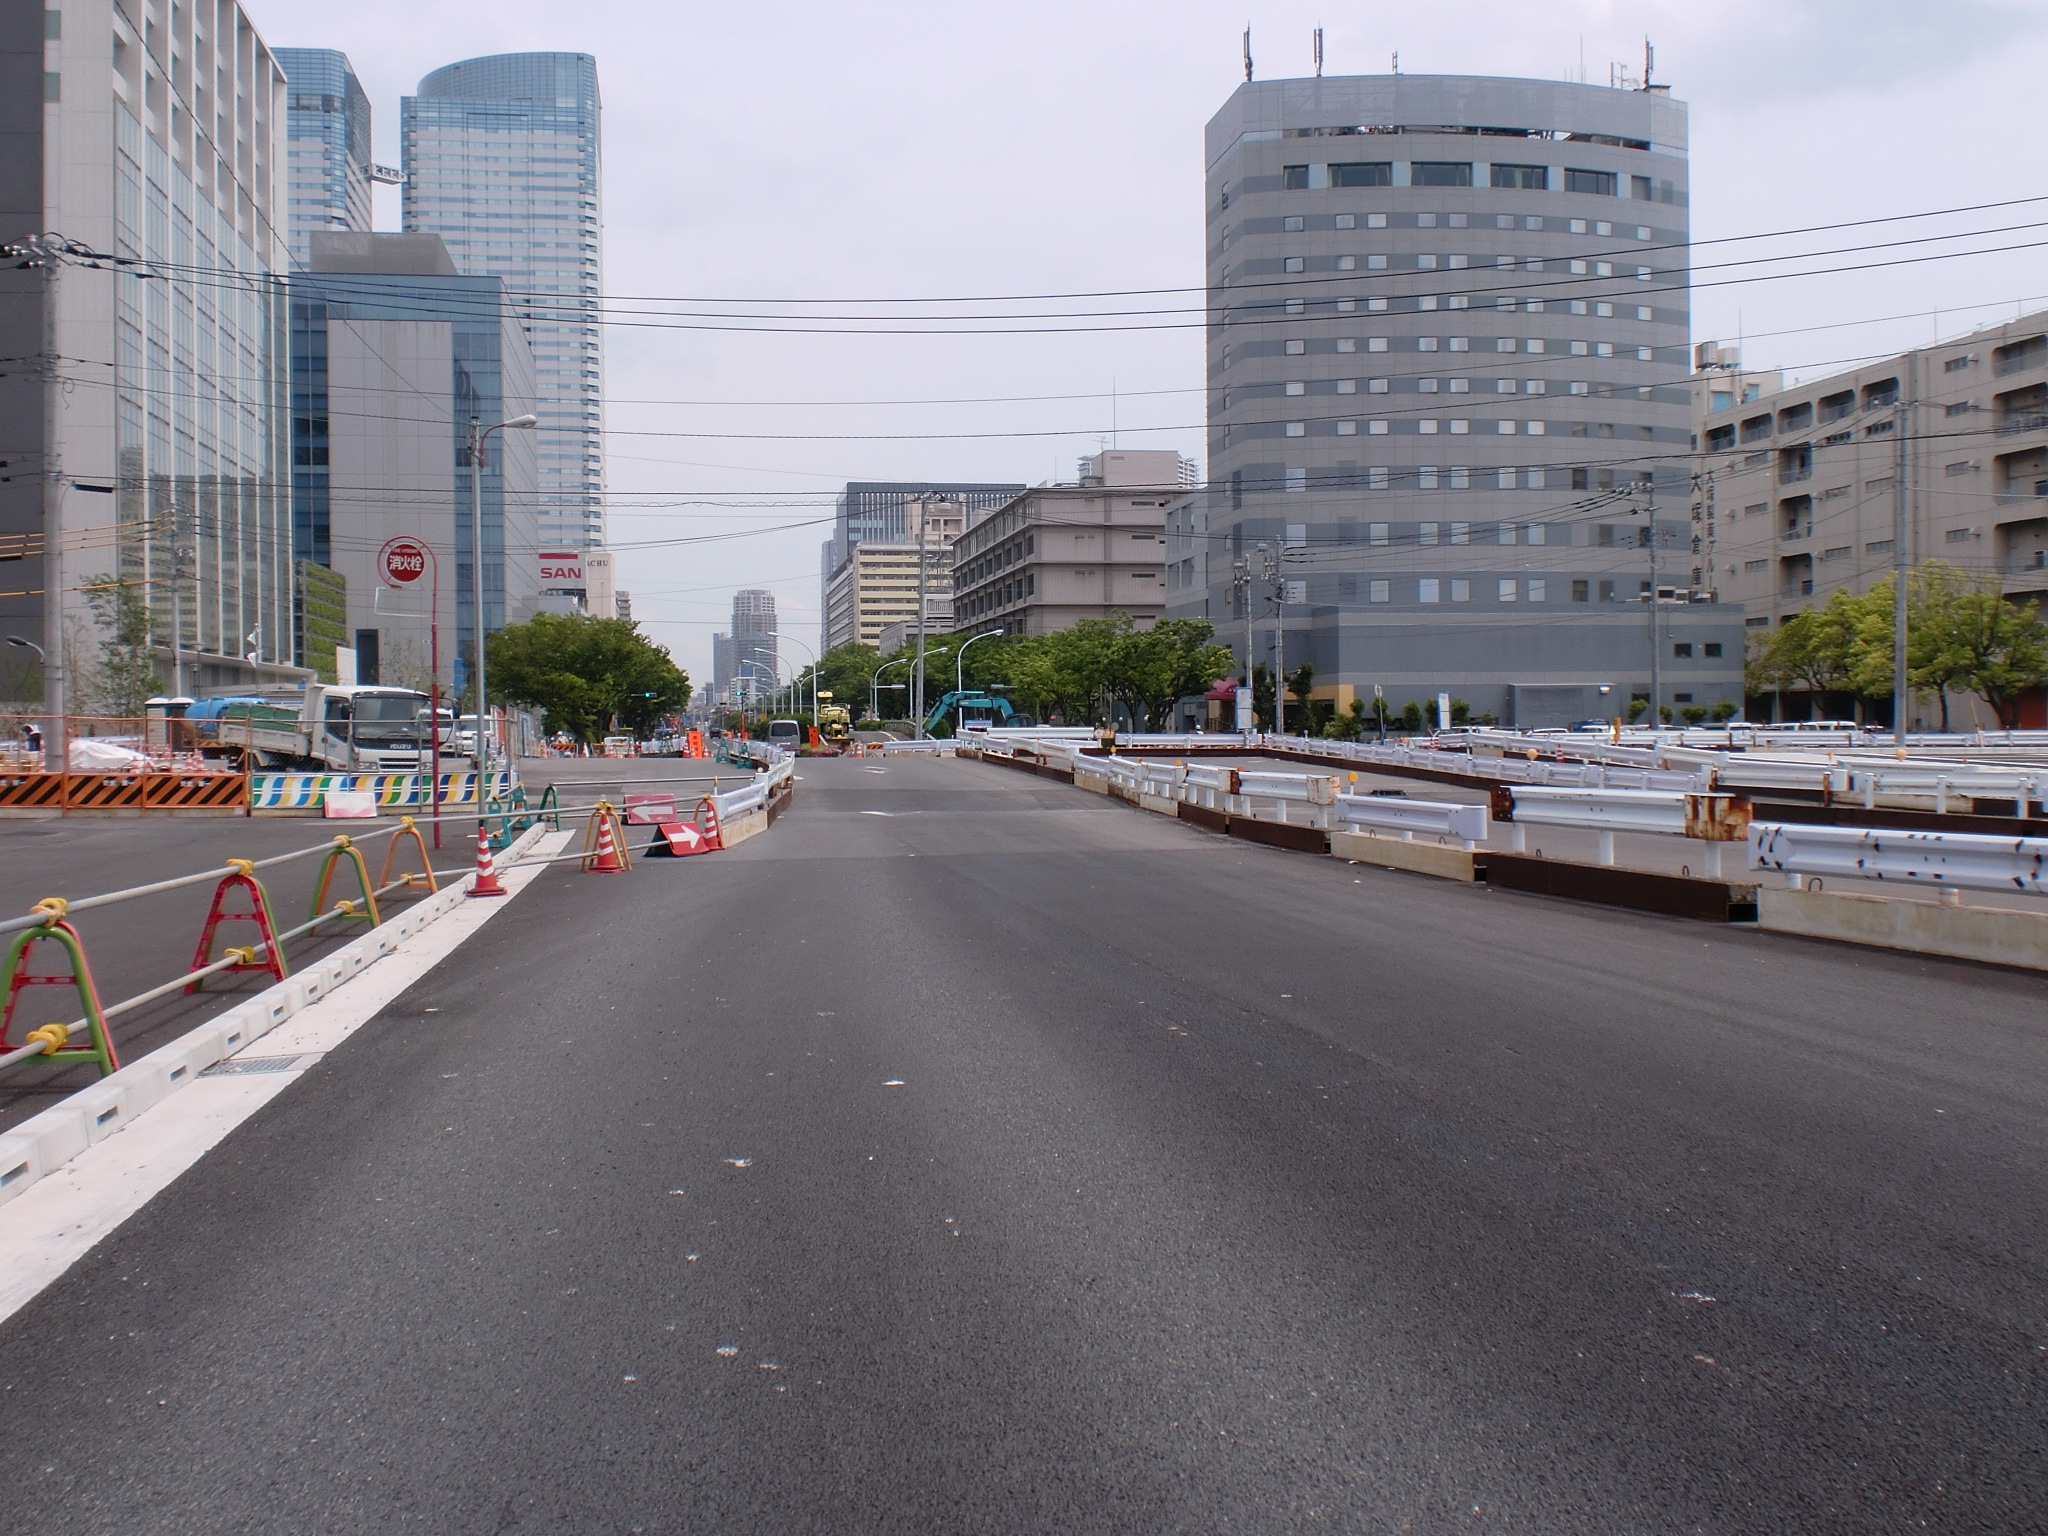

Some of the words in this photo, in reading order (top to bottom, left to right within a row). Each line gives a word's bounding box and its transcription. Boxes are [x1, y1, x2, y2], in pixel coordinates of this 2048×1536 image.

[1691, 471, 1702, 585] 大塚倉庫
[1706, 468, 1716, 592] 大塚製薬グルー
[389, 555, 422, 571] 消火栓
[540, 568, 581, 579] SAN
